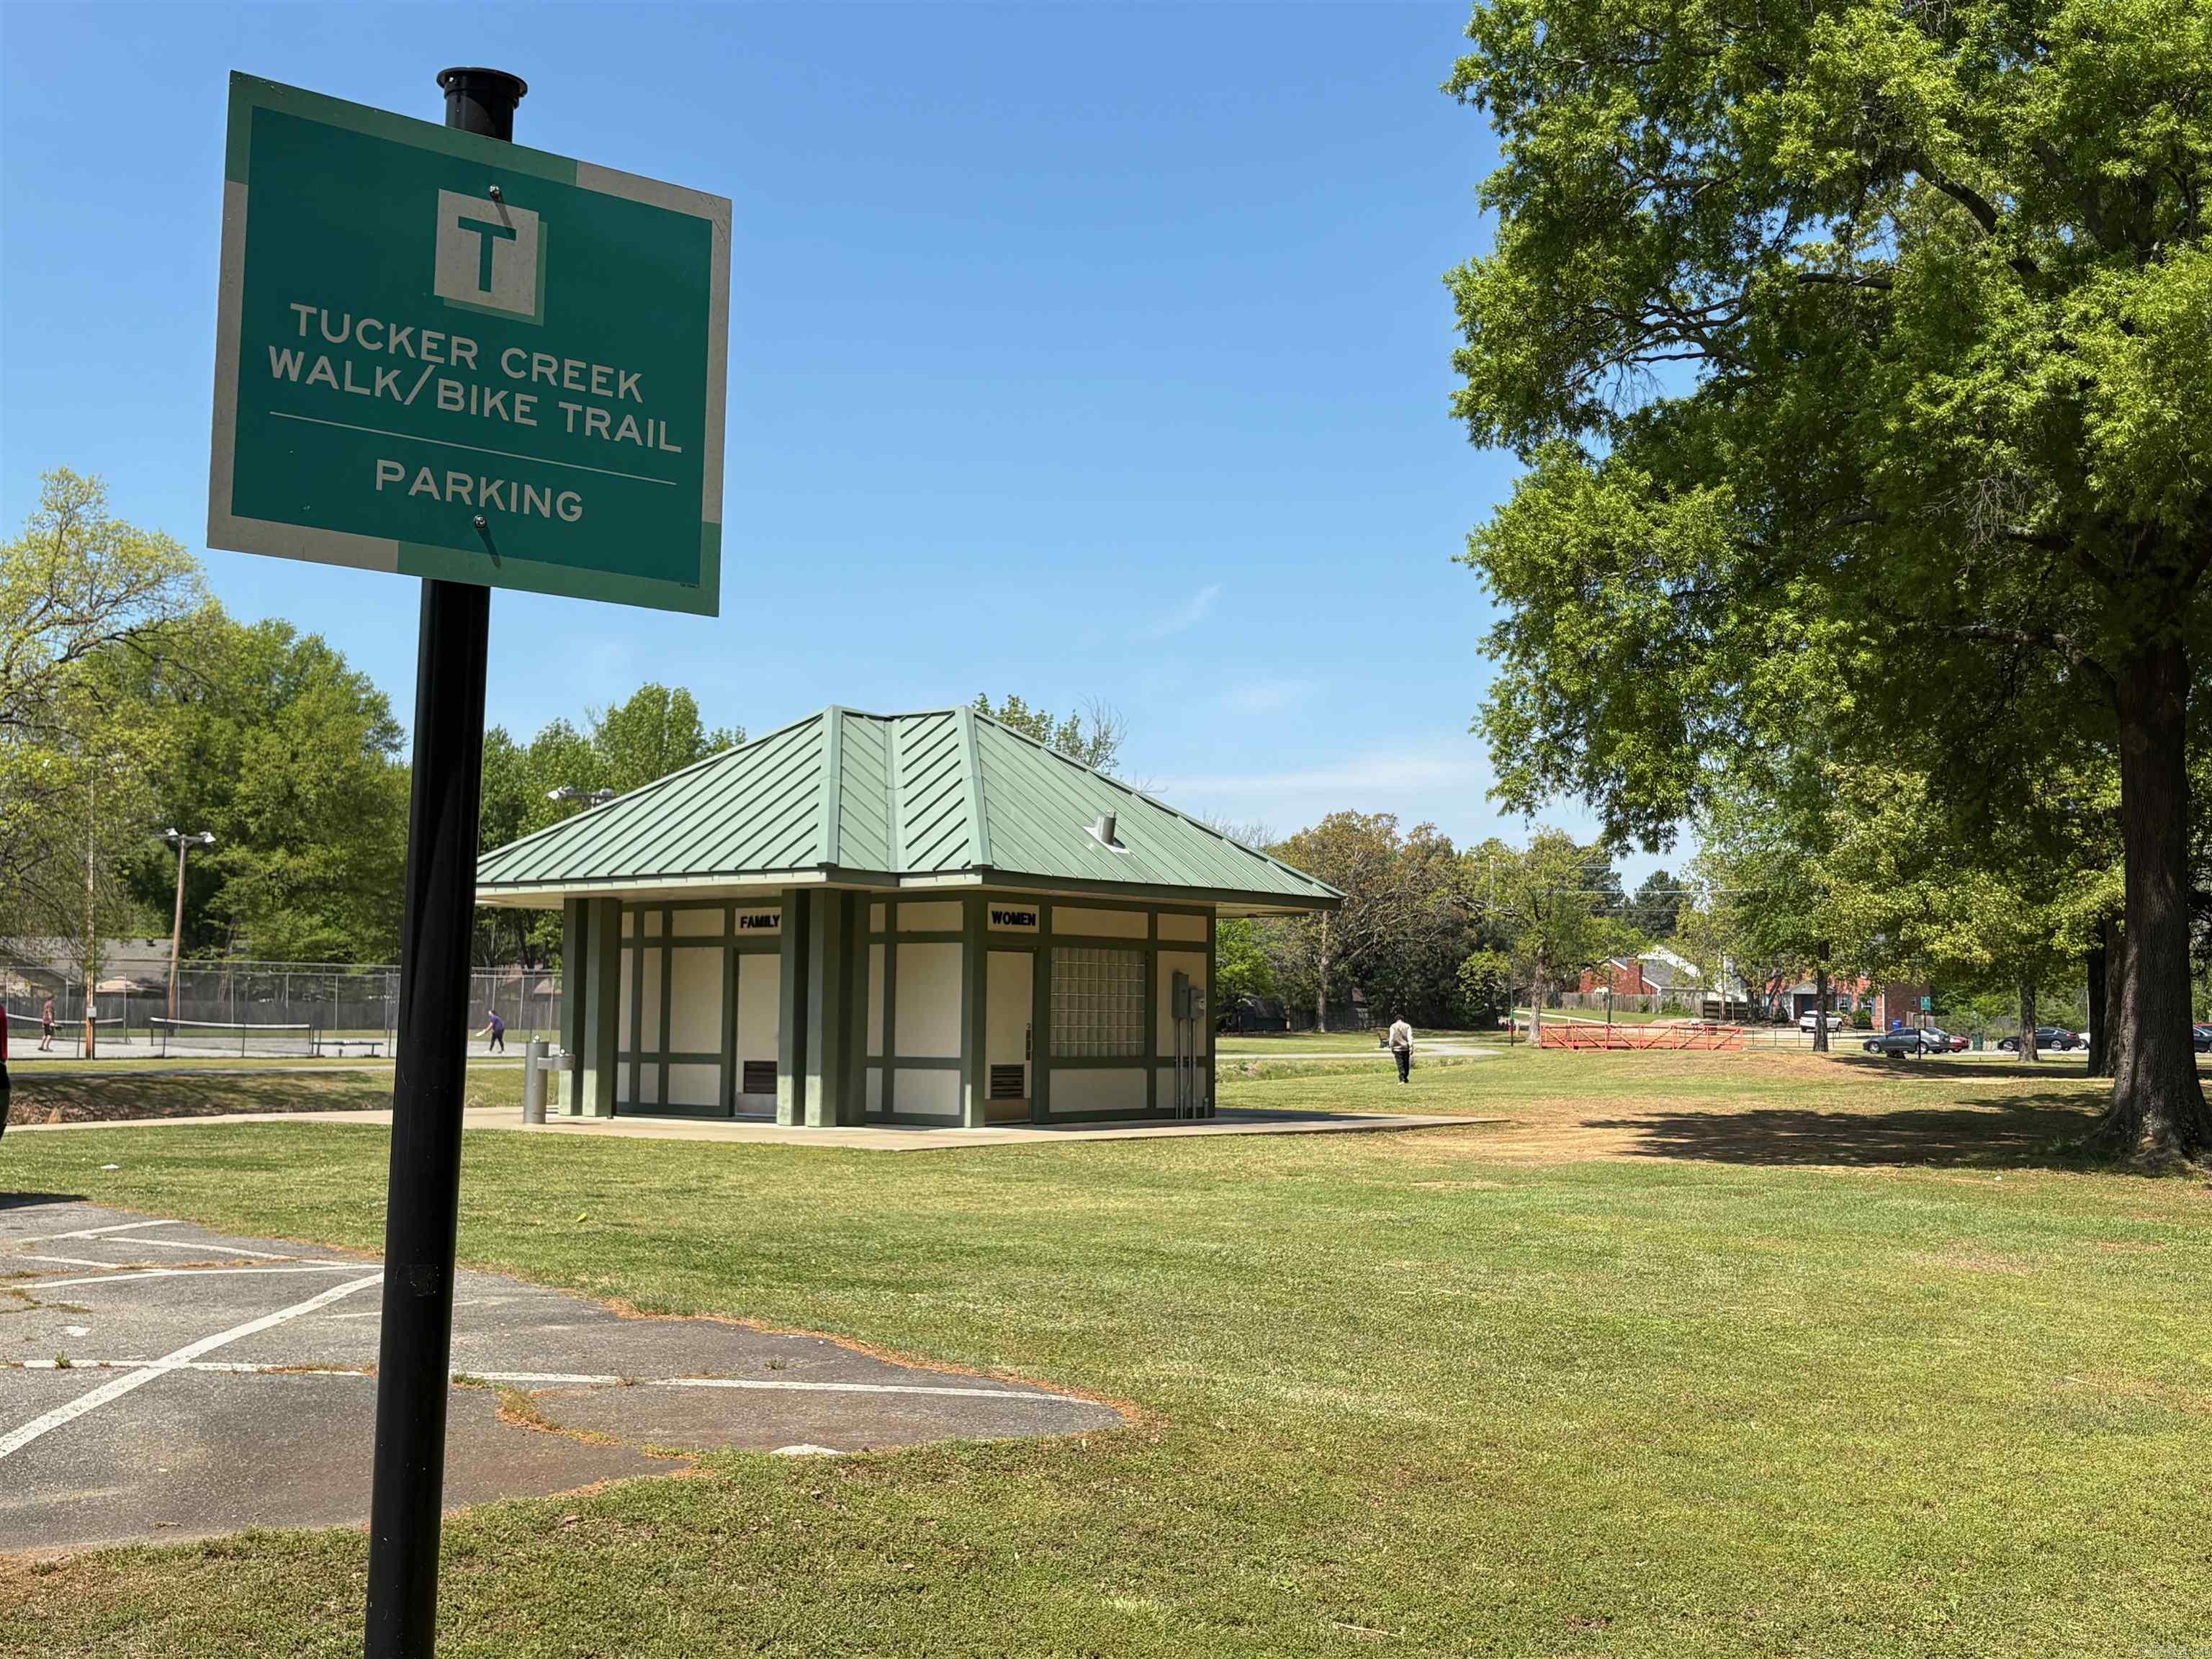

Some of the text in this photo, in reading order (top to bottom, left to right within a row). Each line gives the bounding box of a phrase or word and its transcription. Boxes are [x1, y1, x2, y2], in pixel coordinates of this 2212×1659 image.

[458, 215, 516, 292] T
[290, 302, 643, 403] TUCKER CREEK
[268, 345, 682, 453] WALK/BIKE TRAIL
[375, 459, 583, 522] PARKING
[740, 915, 781, 928] FAMILY
[992, 910, 1036, 926] WOMEN
